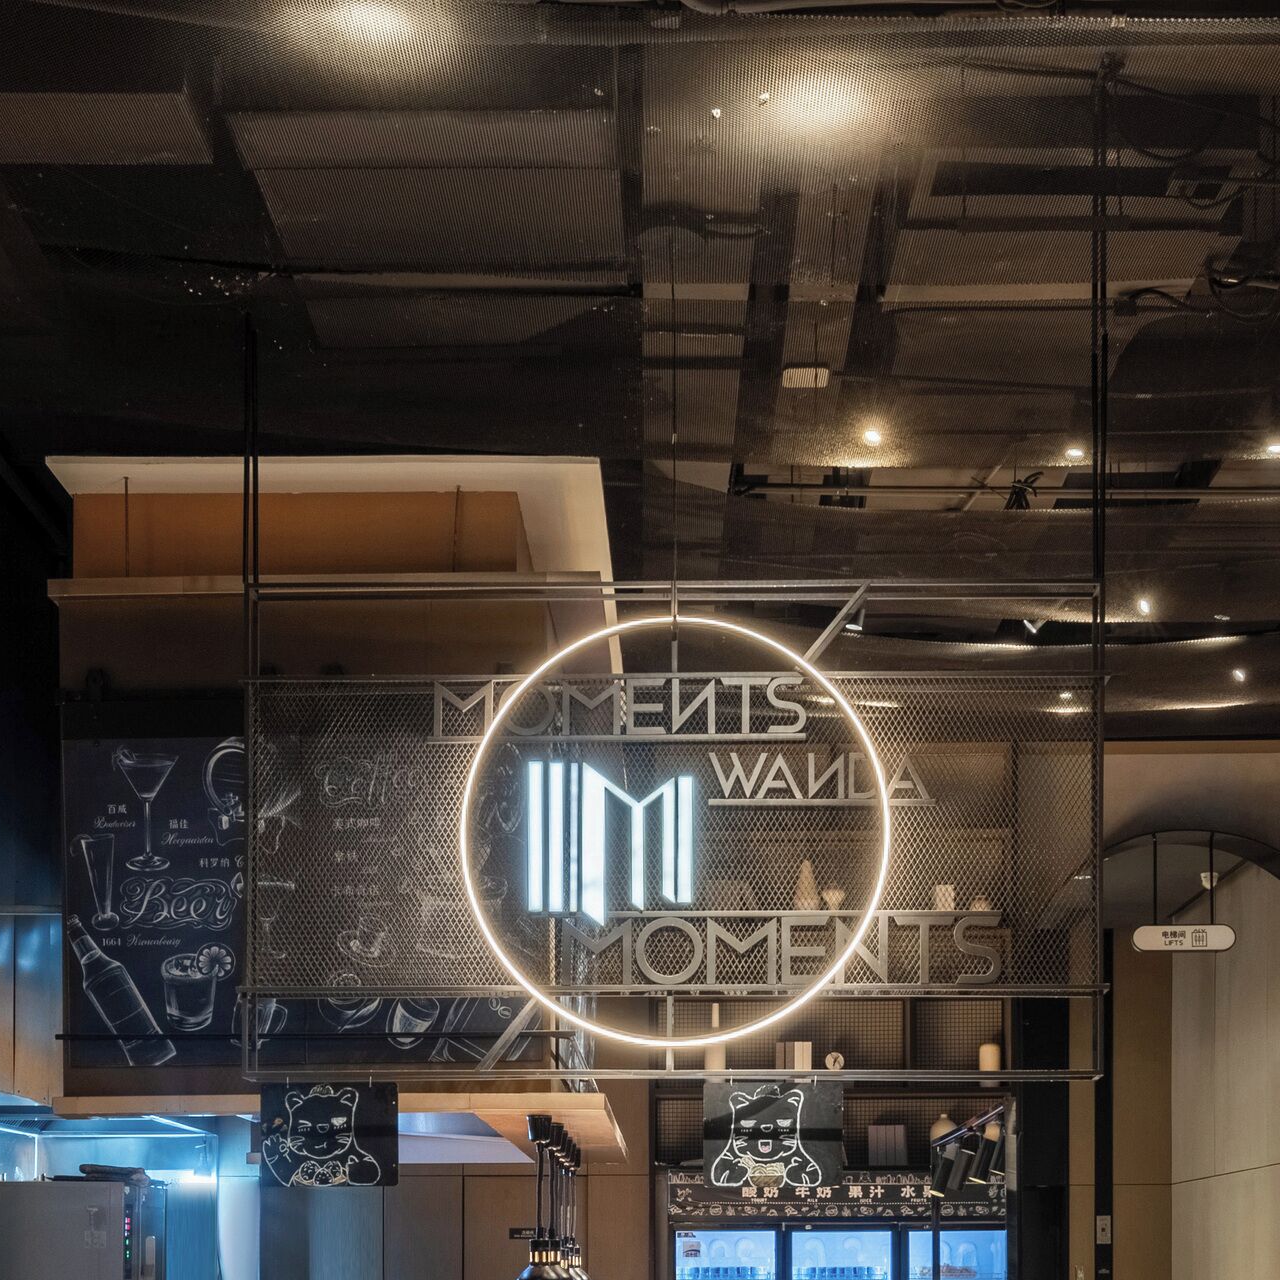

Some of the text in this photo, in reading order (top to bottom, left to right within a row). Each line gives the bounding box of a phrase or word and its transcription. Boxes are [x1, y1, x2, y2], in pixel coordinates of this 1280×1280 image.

[708, 752, 930, 798] WANDA
[108, 804, 127, 814] 百威
[169, 819, 190, 829] 福佳
[121, 877, 232, 928] Beer
[1162, 931, 1186, 939] 电梯间
[562, 916, 1003, 985] MOMENTS
[742, 1187, 779, 1198] 酸奶
[795, 1187, 832, 1198] 牛奶
[849, 1186, 885, 1198] 果汁
